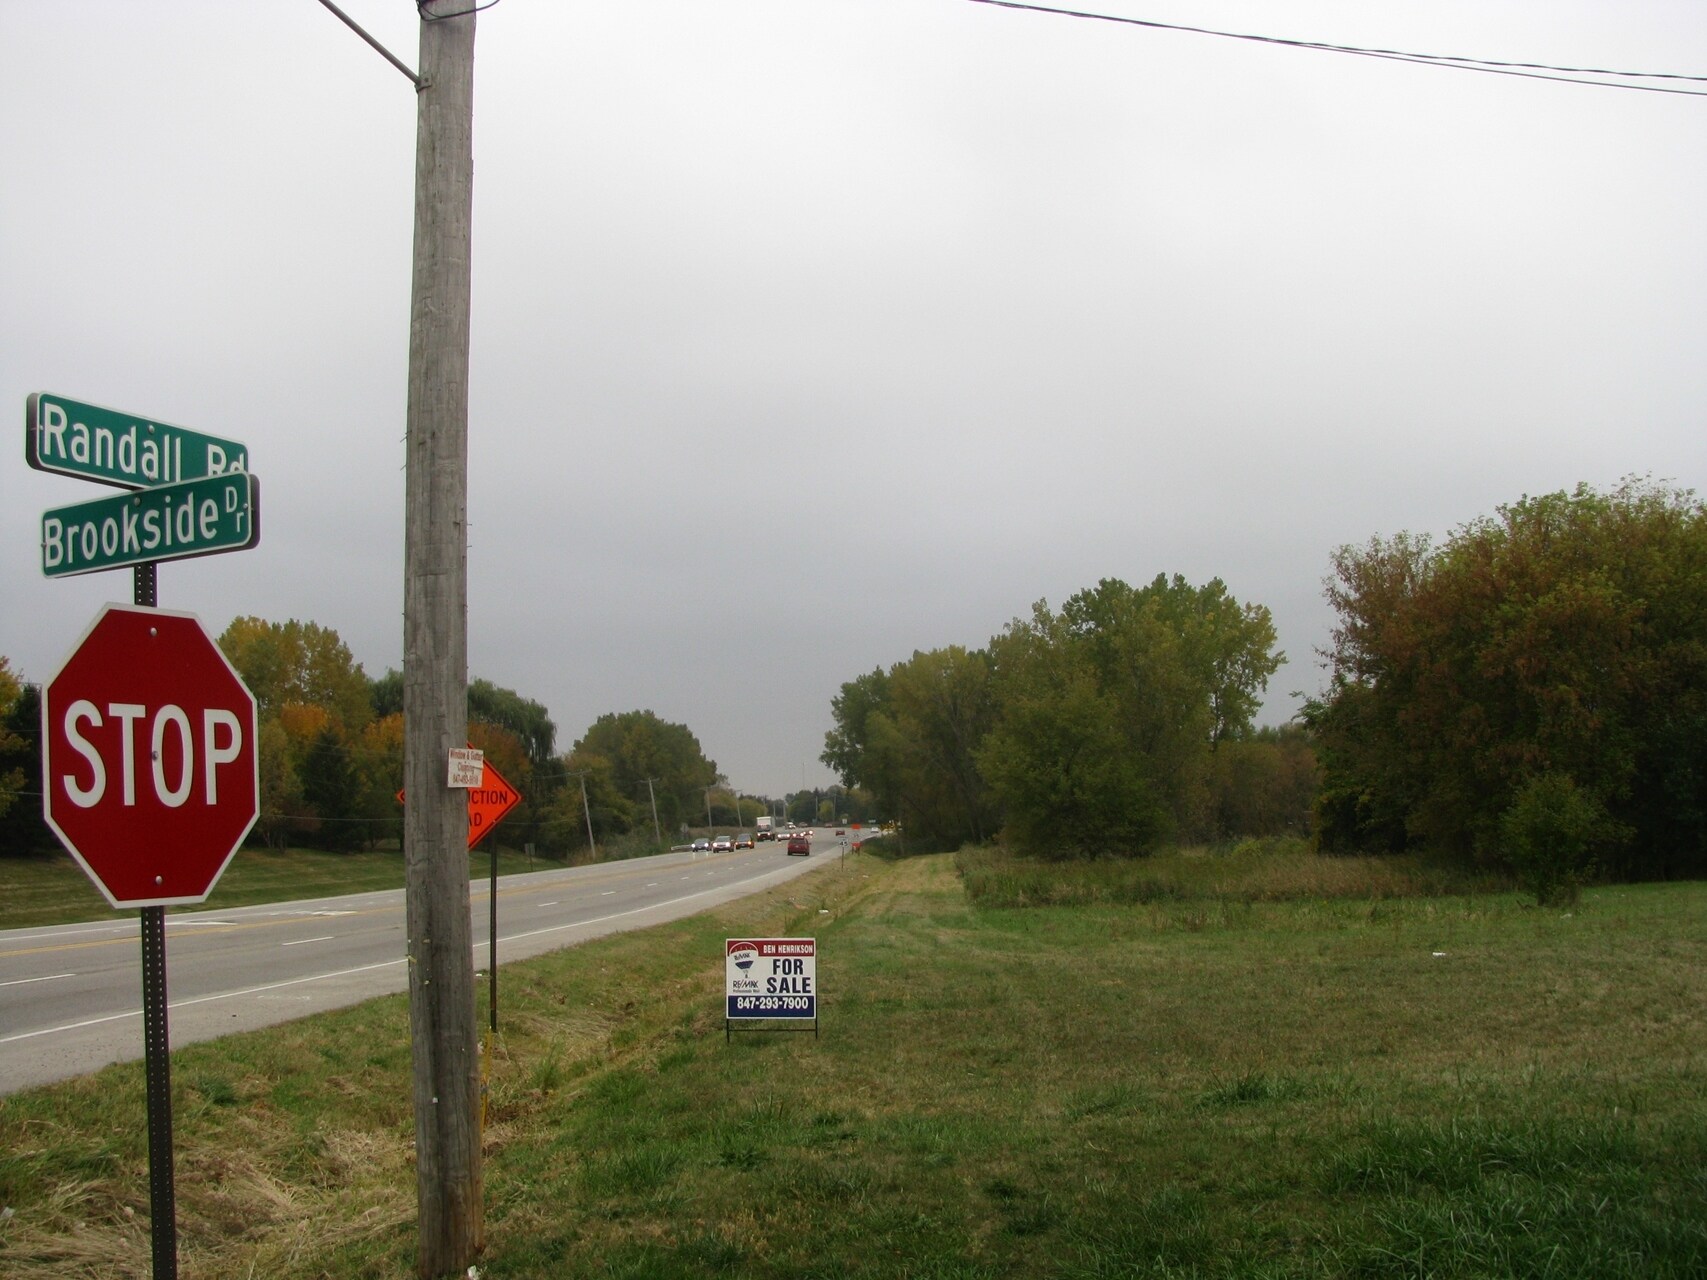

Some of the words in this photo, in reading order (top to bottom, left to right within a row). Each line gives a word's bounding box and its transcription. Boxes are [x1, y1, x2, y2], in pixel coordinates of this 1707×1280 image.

[44, 402, 181, 483] Randall
[44, 491, 219, 567] Brookside
[225, 486, 244, 532] Dr
[63, 699, 242, 808] STOP
[763, 945, 776, 954] BEN
[778, 945, 813, 954] HENRIKSON
[772, 958, 803, 975] FOR
[766, 977, 811, 994] SALE
[737, 997, 809, 1009] 847-293-7900
